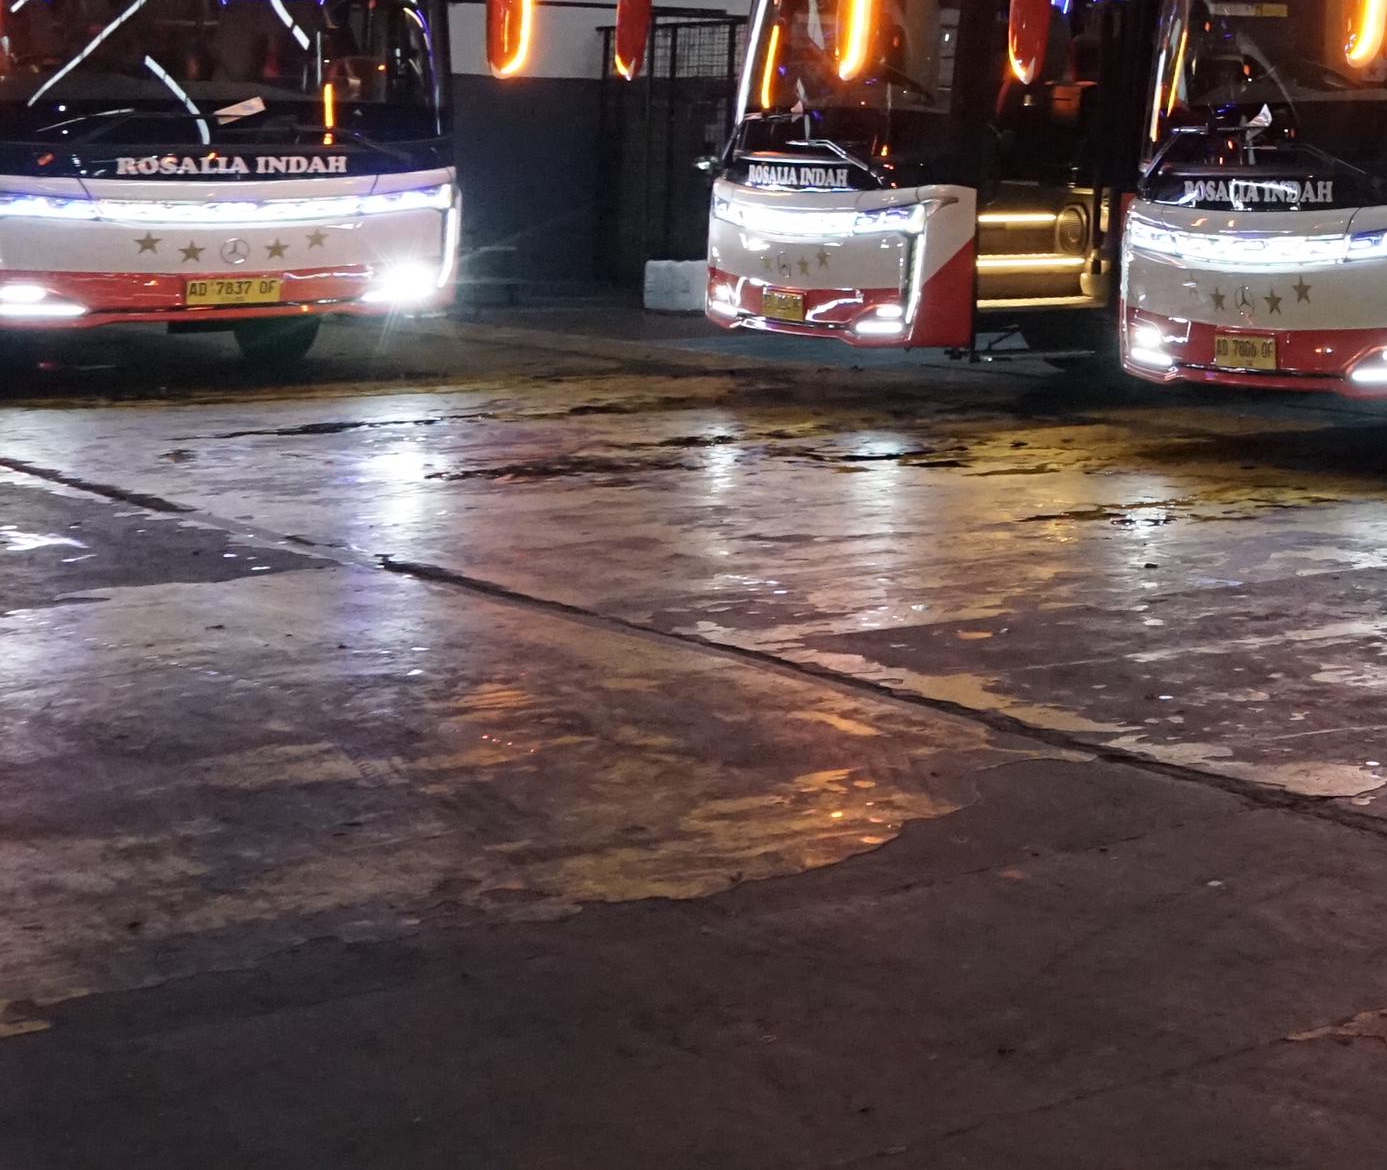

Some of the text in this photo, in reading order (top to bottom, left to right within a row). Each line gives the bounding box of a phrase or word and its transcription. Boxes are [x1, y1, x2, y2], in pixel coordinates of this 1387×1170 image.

[116, 155, 348, 175] ROSALIA INDAH
[748, 164, 849, 187] ROSALIA INDAH
[1183, 180, 1334, 203] ROSALIA INDAH
[188, 280, 277, 296] AD 7837 OF
